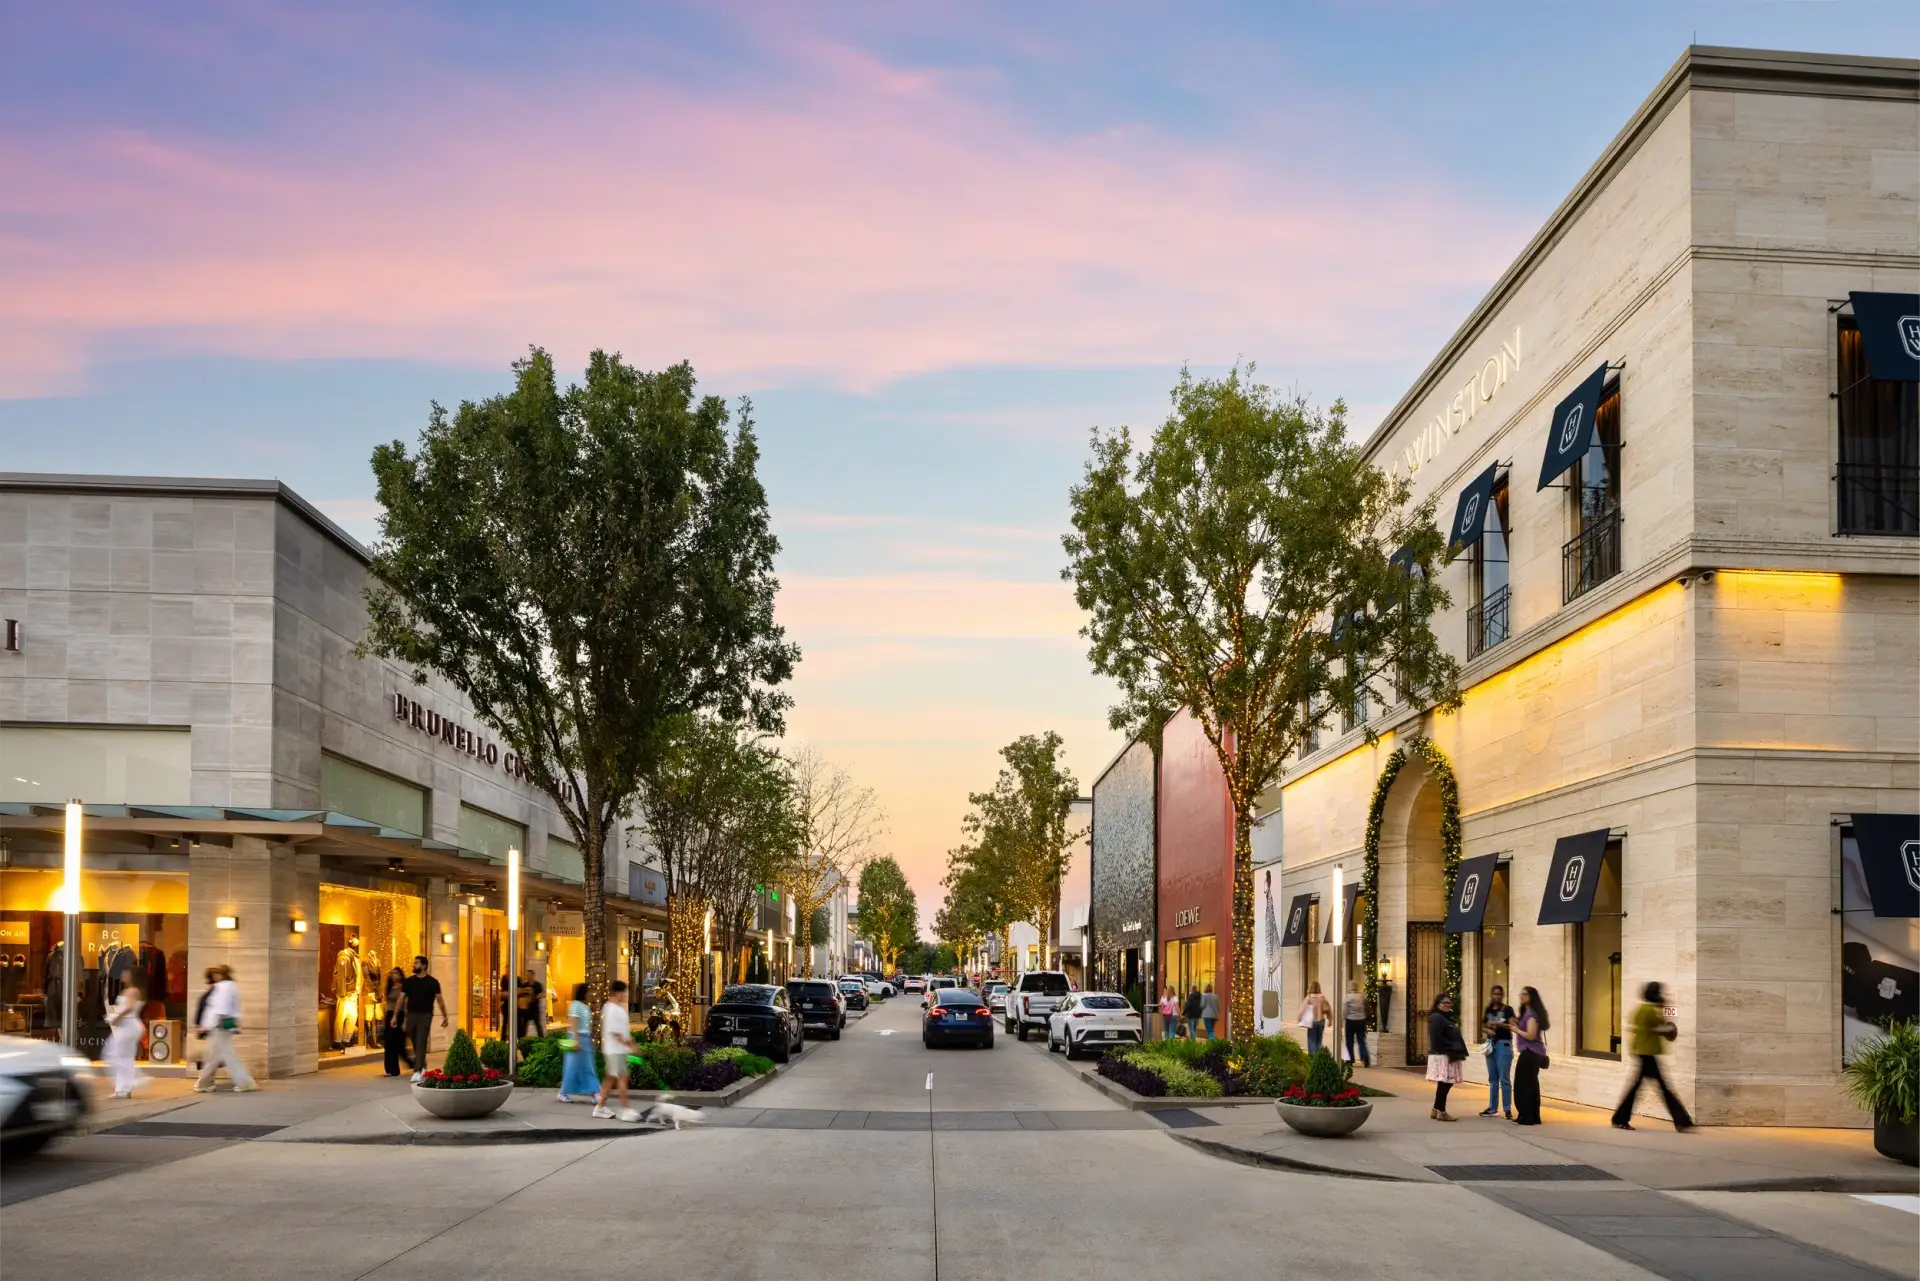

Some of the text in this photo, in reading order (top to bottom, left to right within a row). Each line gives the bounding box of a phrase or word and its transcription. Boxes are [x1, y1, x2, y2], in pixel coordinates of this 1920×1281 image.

[1404, 326, 1521, 480] WINSTON
[394, 691, 498, 767] BRUNELLO
[1175, 906, 1200, 928] LOEWE
[1664, 1007, 1676, 1016] FDC
